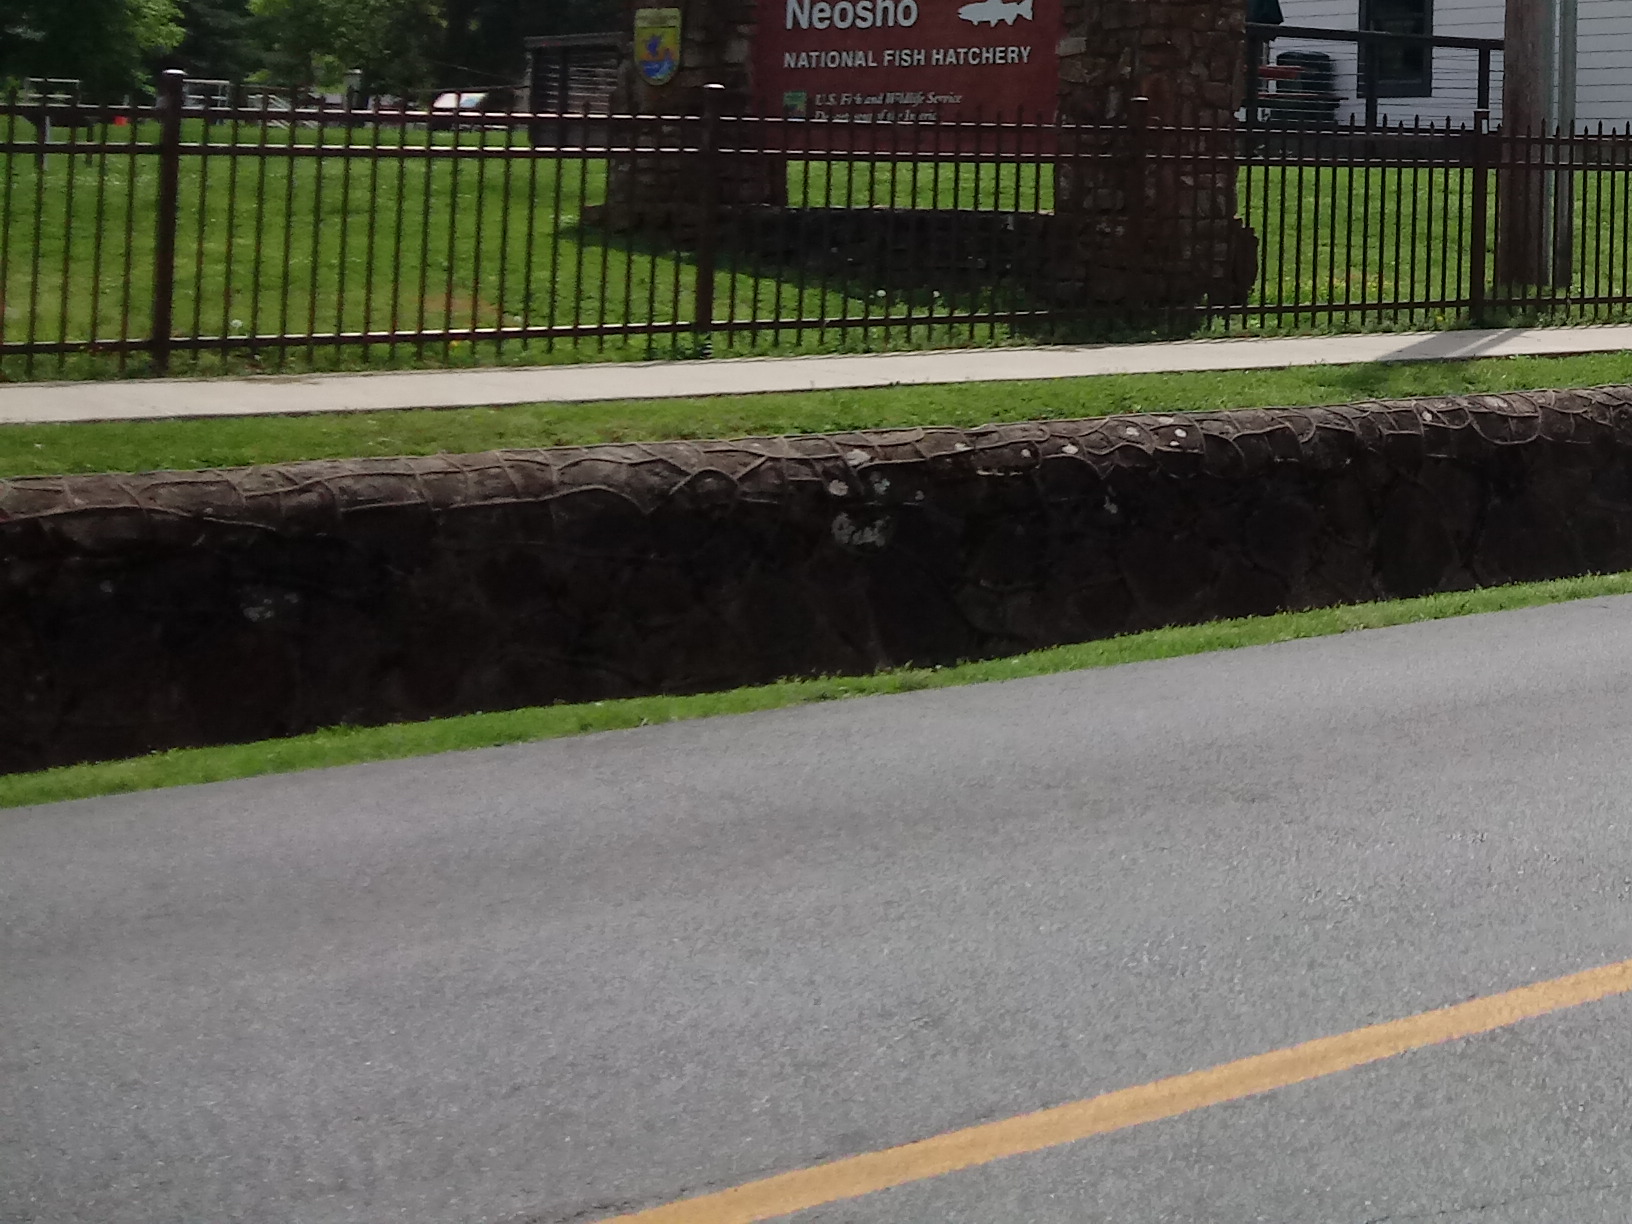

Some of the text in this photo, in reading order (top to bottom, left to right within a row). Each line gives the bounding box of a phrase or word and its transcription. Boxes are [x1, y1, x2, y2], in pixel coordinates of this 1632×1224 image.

[783, 45, 1032, 68] NATIONAL FISH HATCHERY
